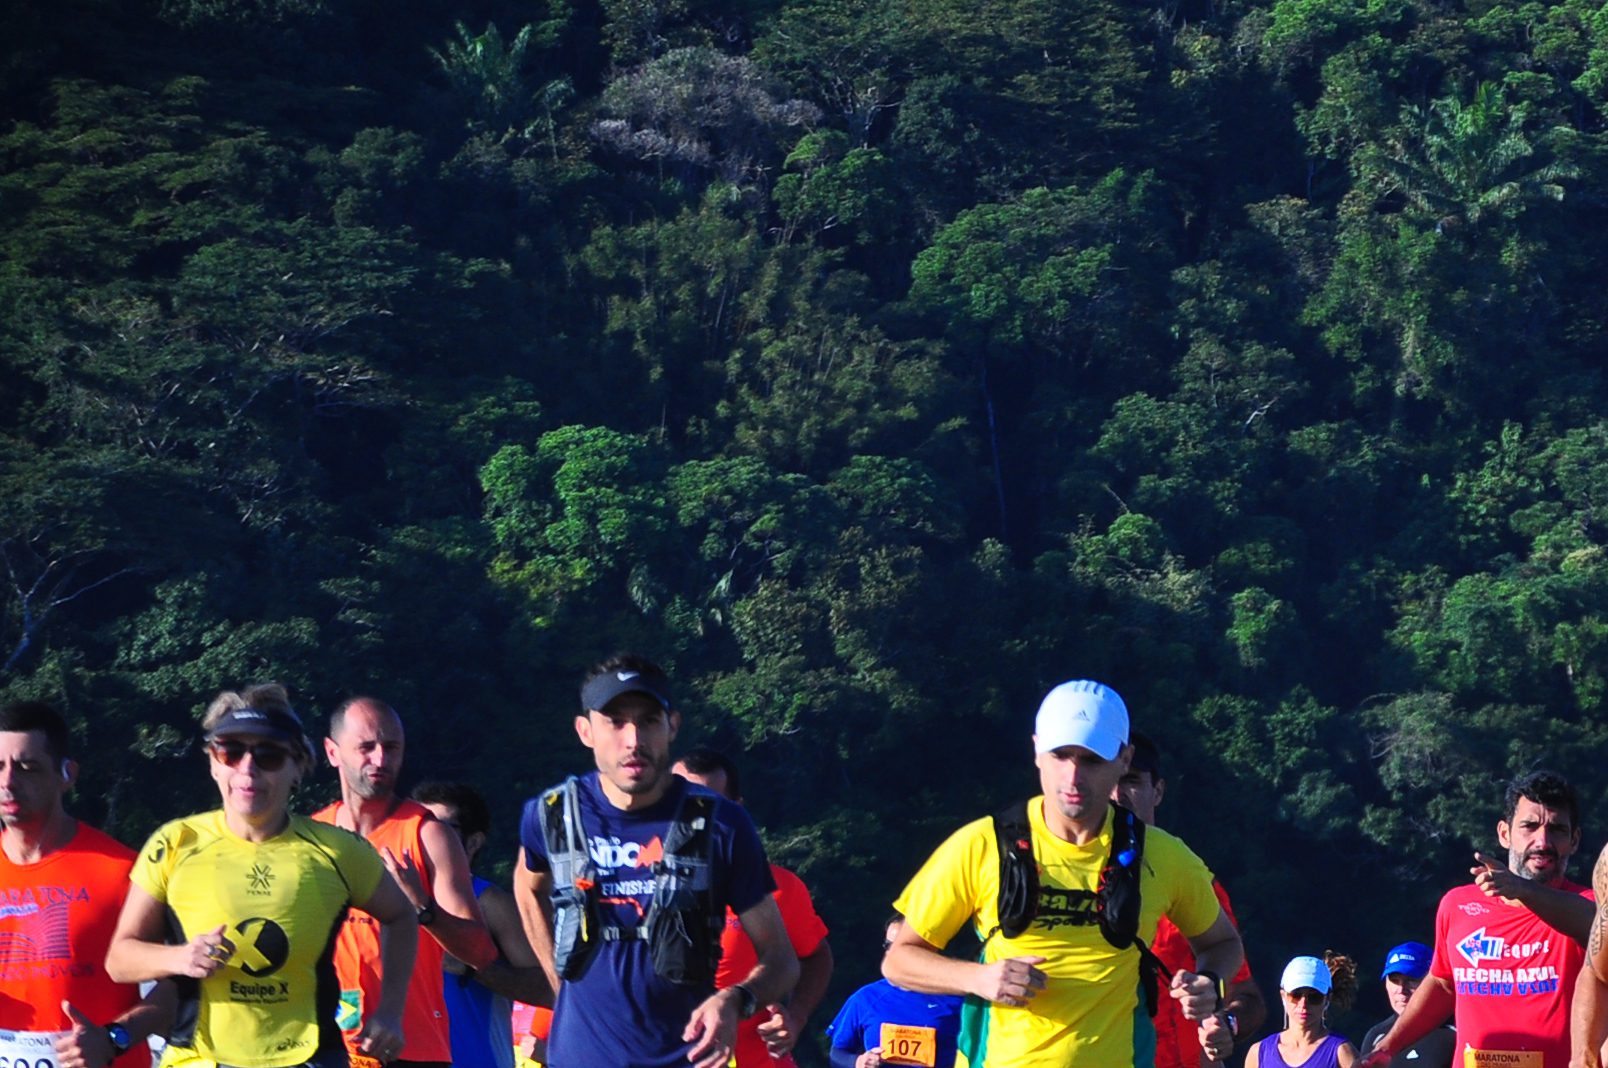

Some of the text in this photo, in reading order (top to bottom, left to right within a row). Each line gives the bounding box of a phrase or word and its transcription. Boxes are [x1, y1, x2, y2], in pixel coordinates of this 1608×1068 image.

[601, 879, 658, 896] FINISHE
[1454, 966, 1559, 983] FLECHA AZUL
[230, 981, 289, 999] Equipe X
[887, 1039, 922, 1057] 107
[1474, 1051, 1520, 1062] MARATONA
